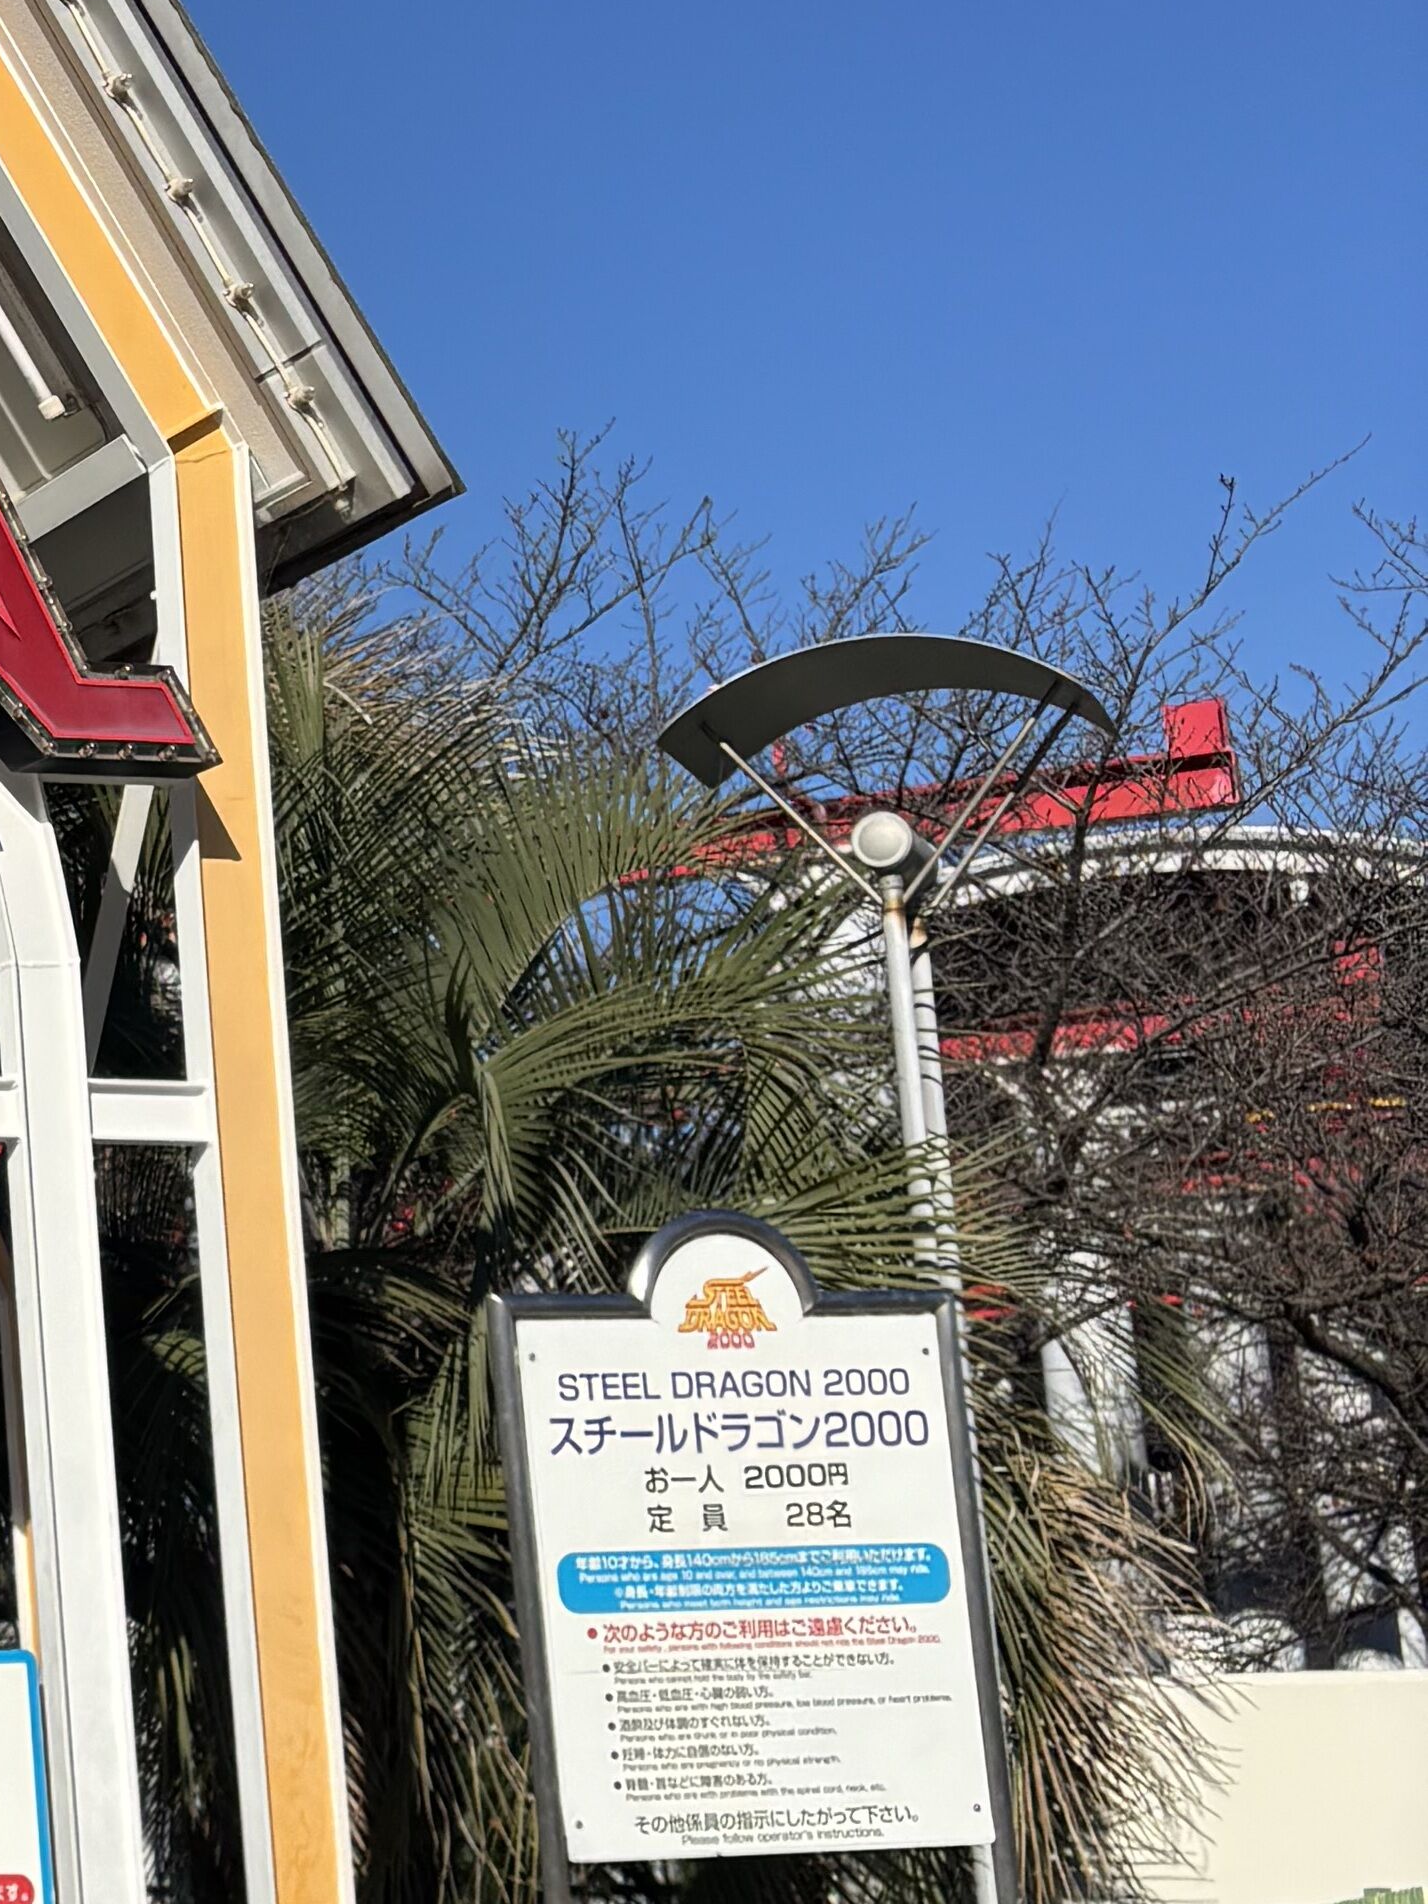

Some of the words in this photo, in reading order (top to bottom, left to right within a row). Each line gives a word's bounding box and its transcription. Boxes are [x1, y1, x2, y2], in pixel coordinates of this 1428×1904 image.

[685, 1267, 769, 1309] STEEL
[678, 1307, 776, 1333] DRAGON
[707, 1332, 755, 1349] 2000
[558, 1372, 661, 1401] STEEL
[671, 1369, 811, 1398] DRAGON
[823, 1368, 909, 1395] 2000
[549, 1410, 929, 1455] スチールドラゴン2000
[644, 1465, 724, 1493] お一人
[744, 1463, 849, 1489] 2000円
[786, 1500, 852, 1529] 28名
[634, 1805, 919, 1835] その他係員の指示にしたがって下さい。
[681, 1833, 718, 1845] Please
[722, 1831, 753, 1844] follow
